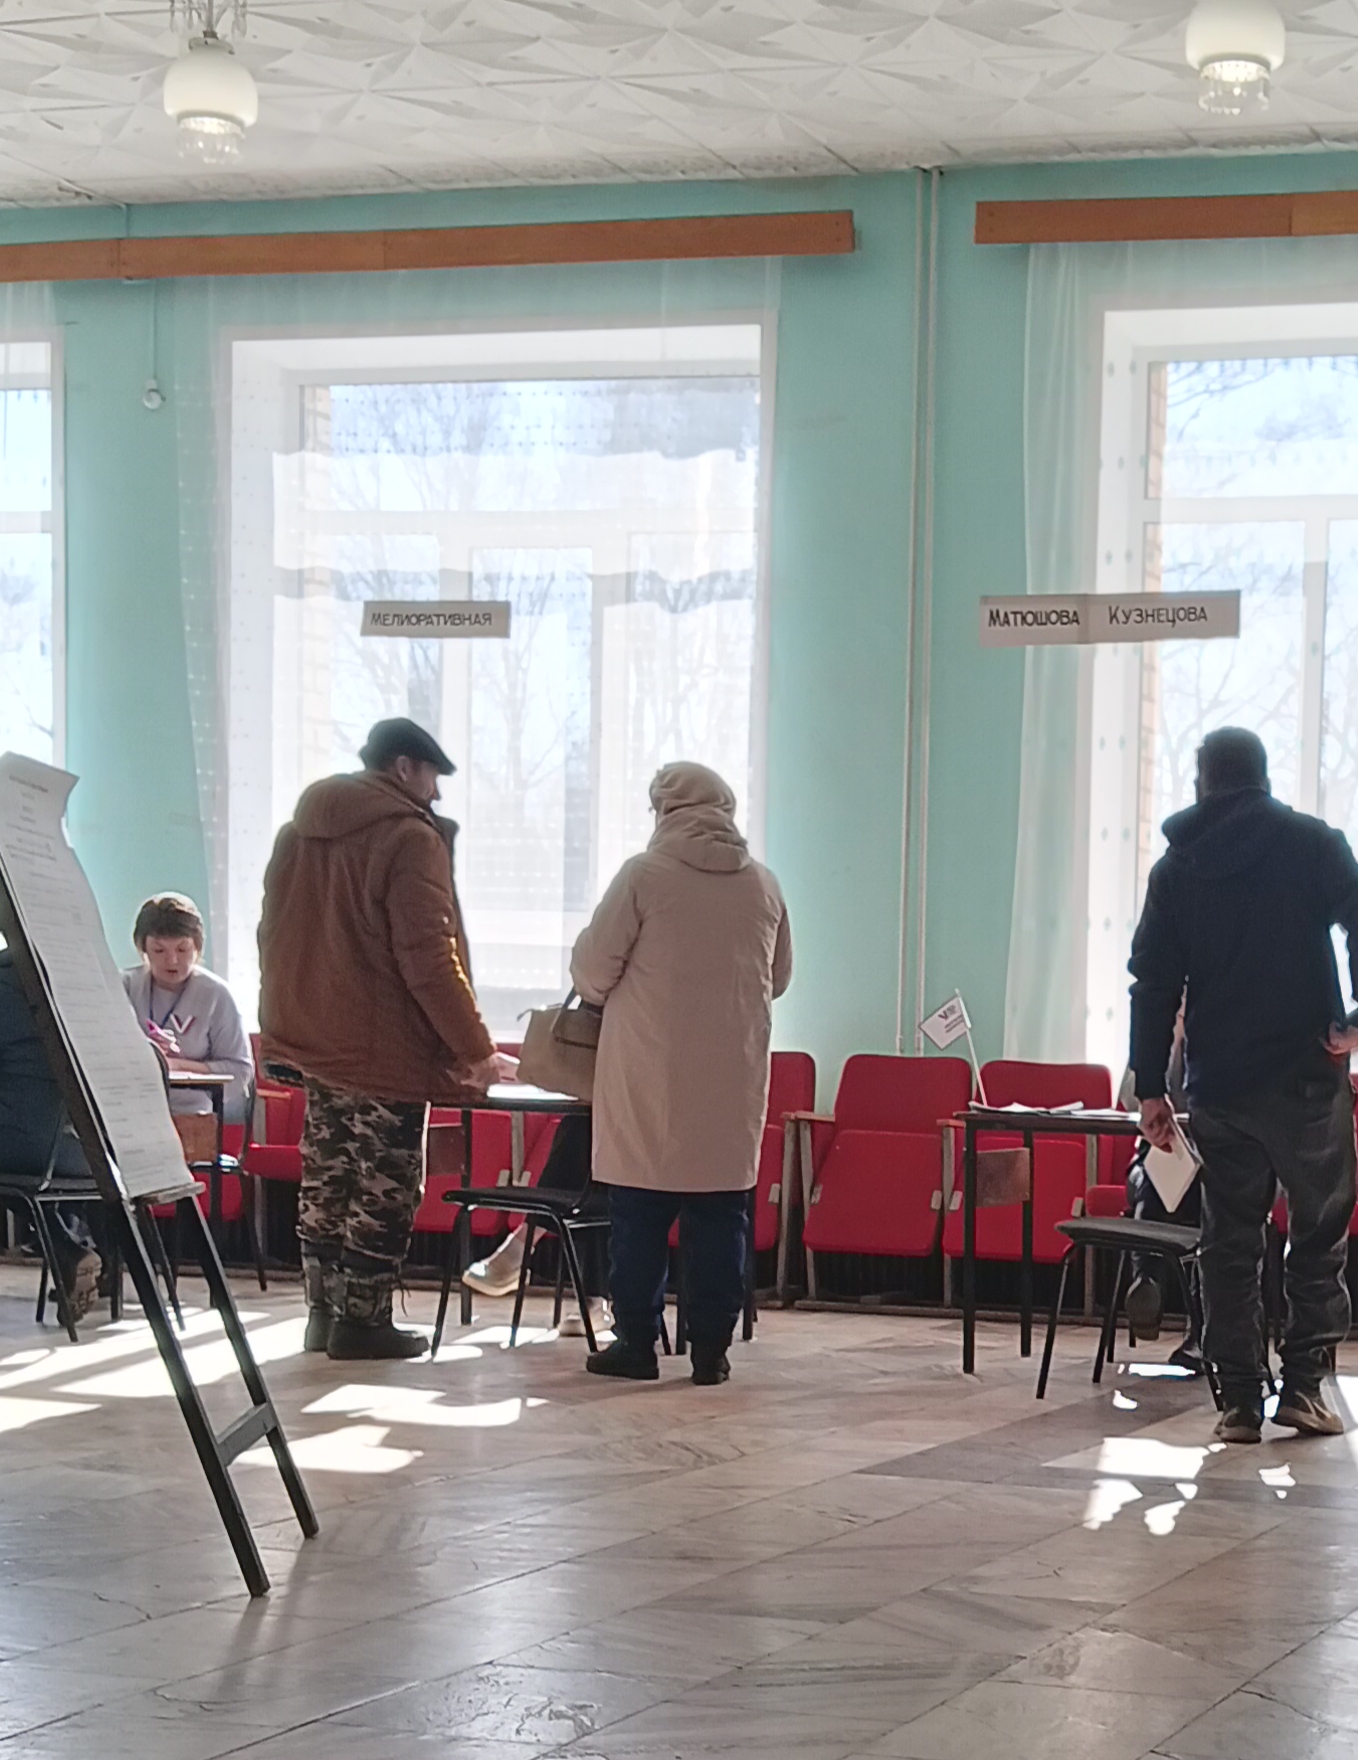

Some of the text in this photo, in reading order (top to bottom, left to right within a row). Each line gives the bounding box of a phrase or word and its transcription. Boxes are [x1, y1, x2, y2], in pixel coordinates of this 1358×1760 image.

[370, 612, 492, 627] МЕЛИОРАТИВНАЯ
[988, 609, 1080, 627] МАТЮШОВА
[1108, 605, 1208, 628] КУЗНЕЦОВА
